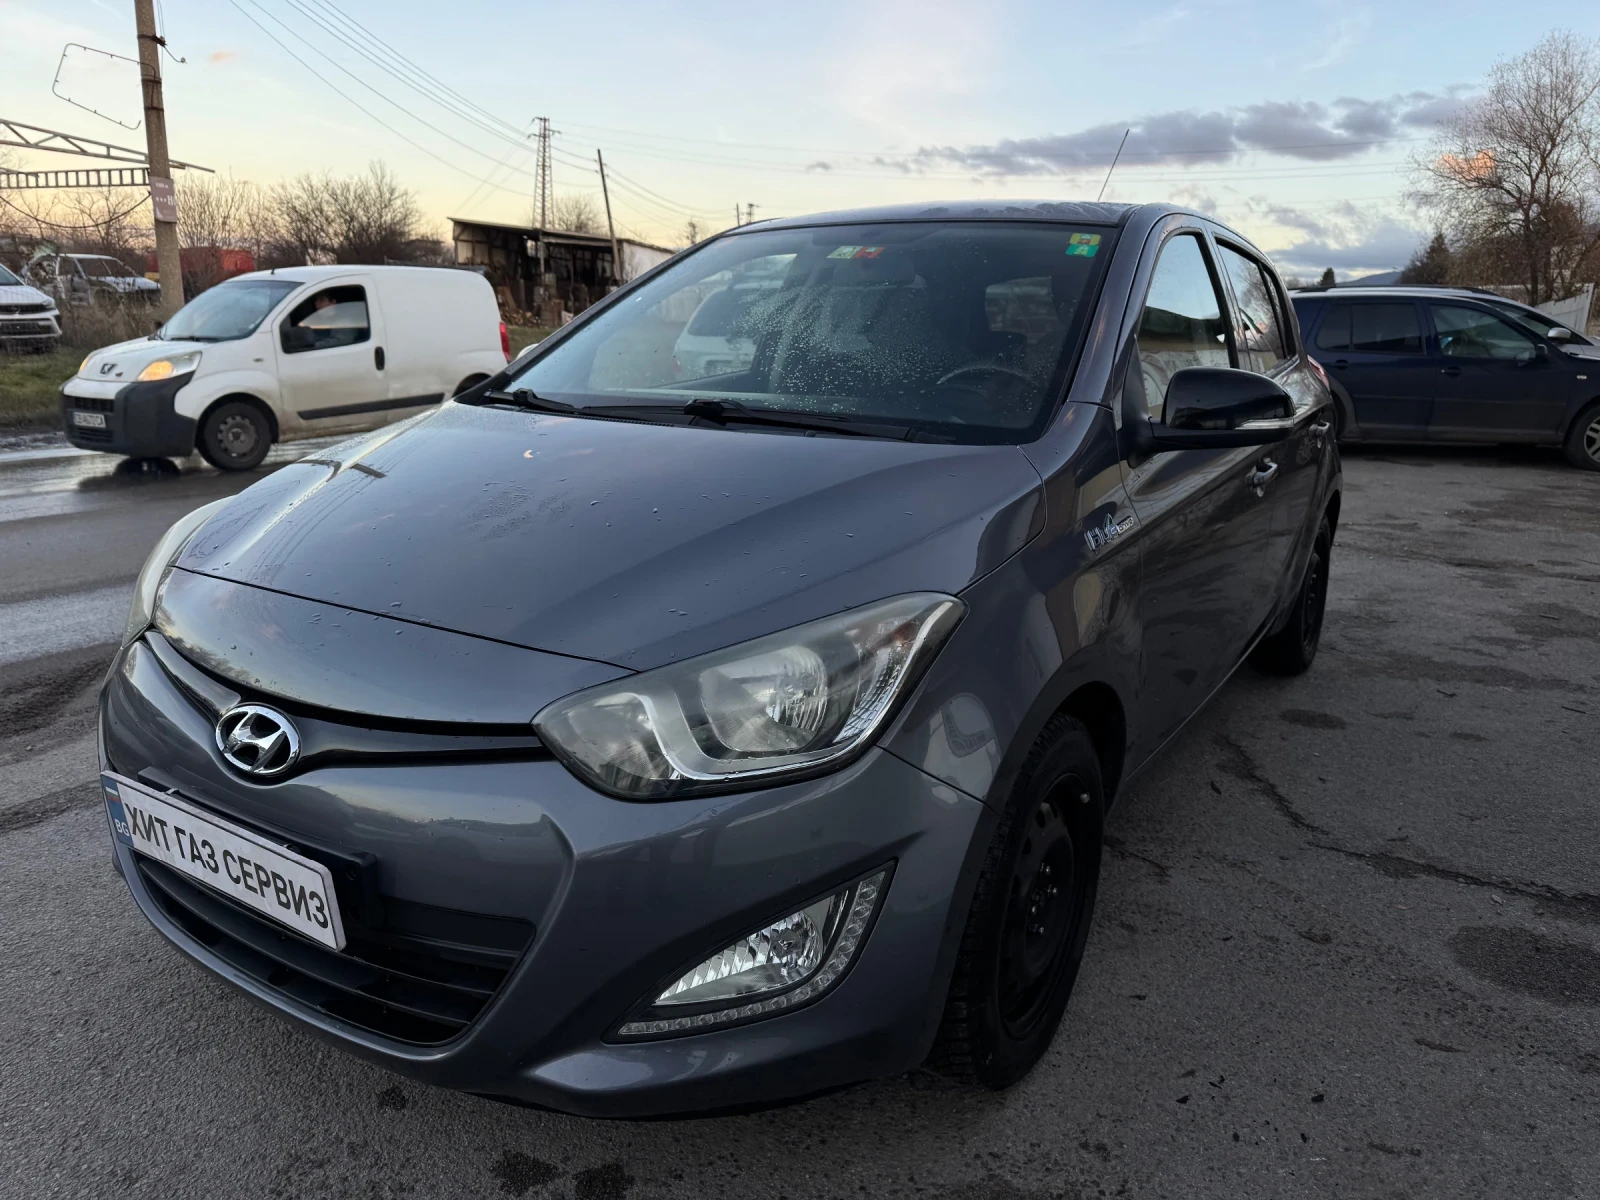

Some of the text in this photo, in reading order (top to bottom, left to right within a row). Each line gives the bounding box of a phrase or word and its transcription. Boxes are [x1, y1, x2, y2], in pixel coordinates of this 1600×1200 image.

[114, 818, 130, 837] BG
[124, 802, 329, 930] ХИТ ГАЗ СЕРВИЗ
